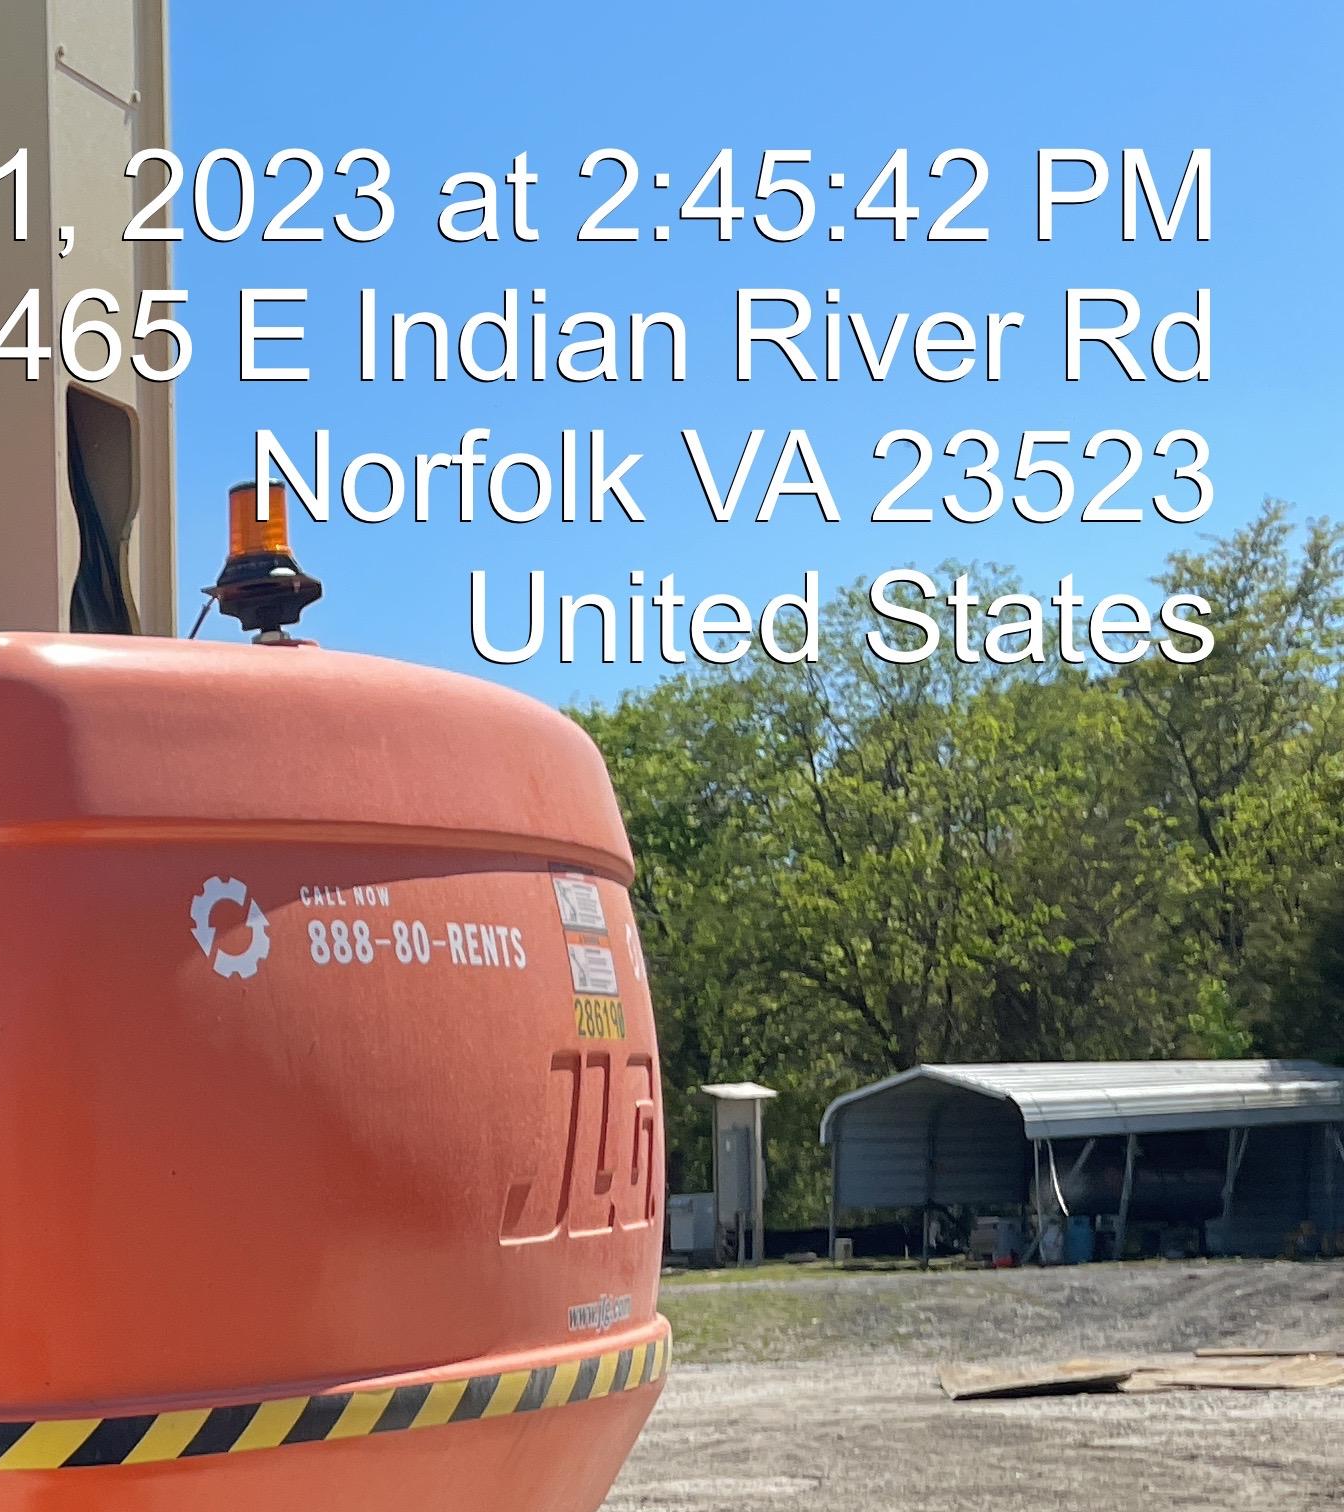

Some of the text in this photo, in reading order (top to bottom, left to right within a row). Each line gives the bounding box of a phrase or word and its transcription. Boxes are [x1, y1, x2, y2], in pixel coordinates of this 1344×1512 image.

[300, 885, 390, 907] CALL NOW
[307, 919, 527, 970] 888-80-RENTS
